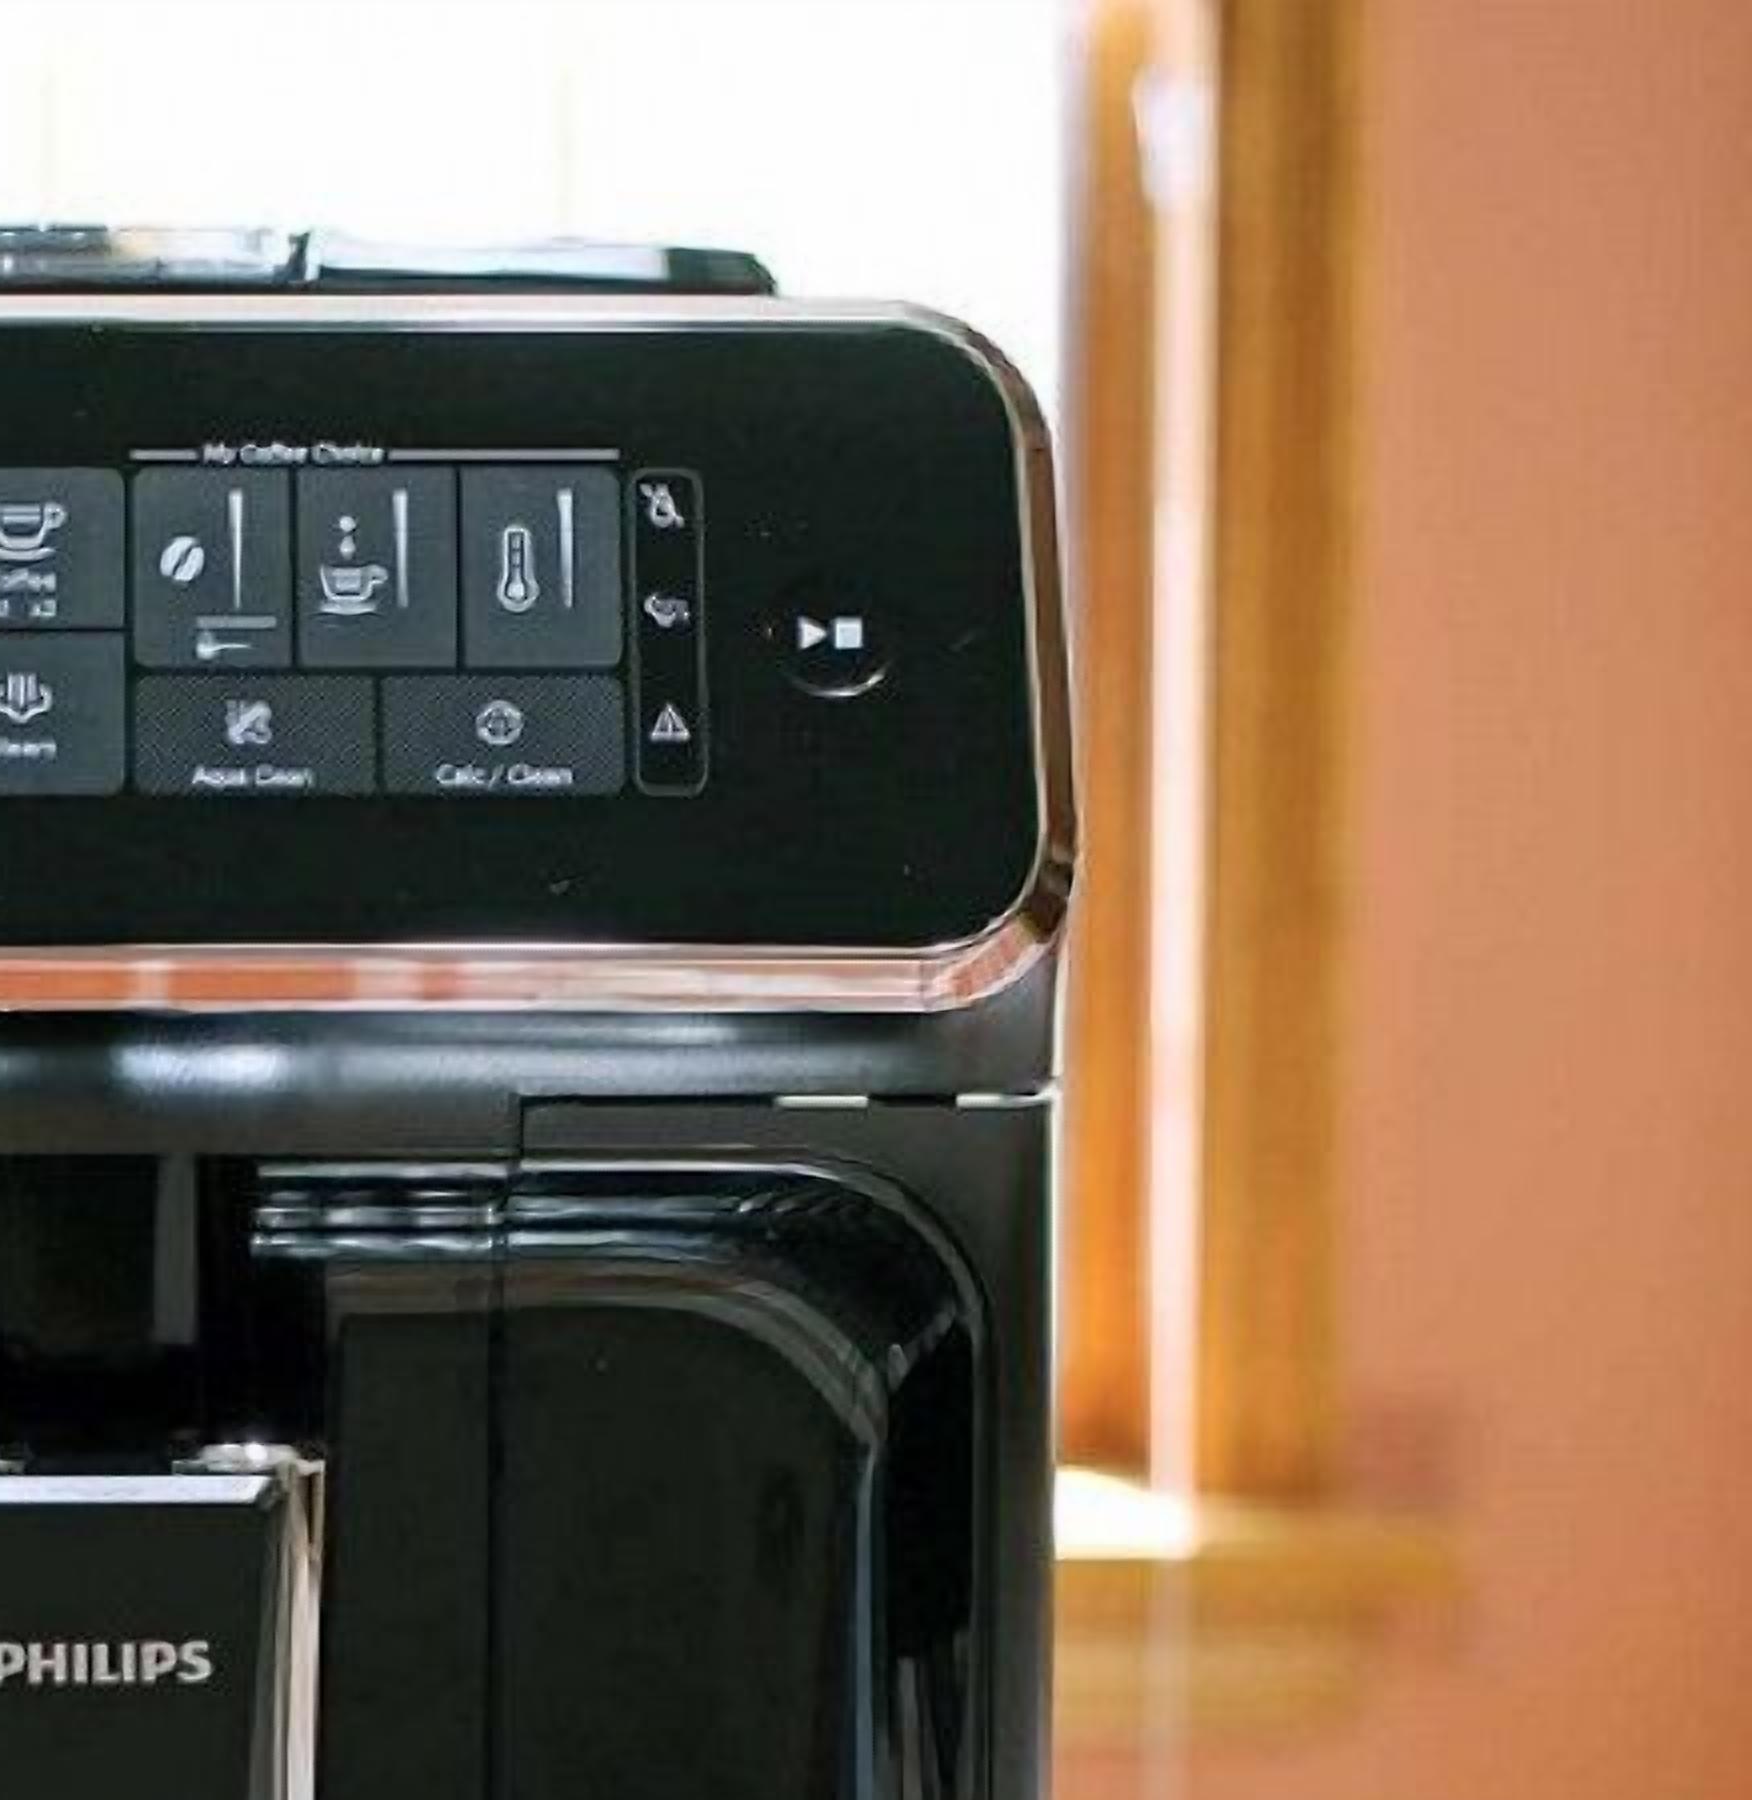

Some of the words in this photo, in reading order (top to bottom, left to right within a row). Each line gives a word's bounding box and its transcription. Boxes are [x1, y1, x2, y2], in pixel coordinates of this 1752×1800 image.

[203, 441, 237, 465] My
[239, 442, 308, 465] Coffee
[435, 763, 486, 788] Calc
[508, 763, 573, 787] Clean
